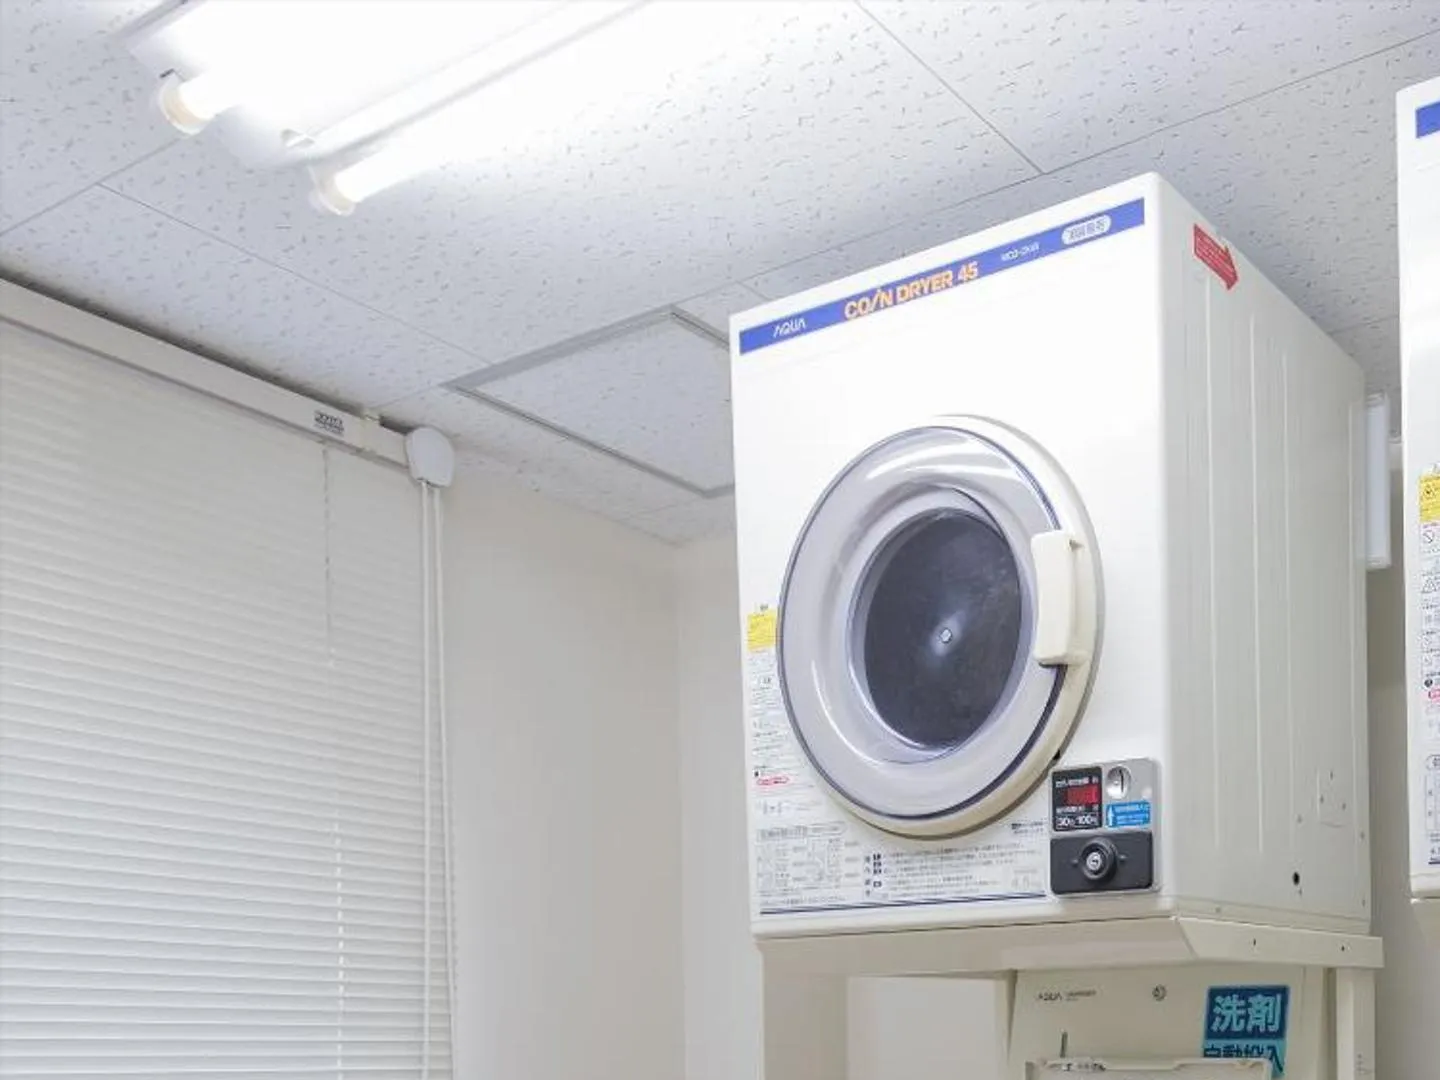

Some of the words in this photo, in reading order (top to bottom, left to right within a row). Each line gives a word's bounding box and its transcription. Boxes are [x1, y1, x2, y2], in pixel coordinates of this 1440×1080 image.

[897, 270, 953, 302] DRYER
[958, 261, 978, 282] 45
[773, 318, 806, 338] AQUA
[1210, 993, 1282, 1033] 洗剤
